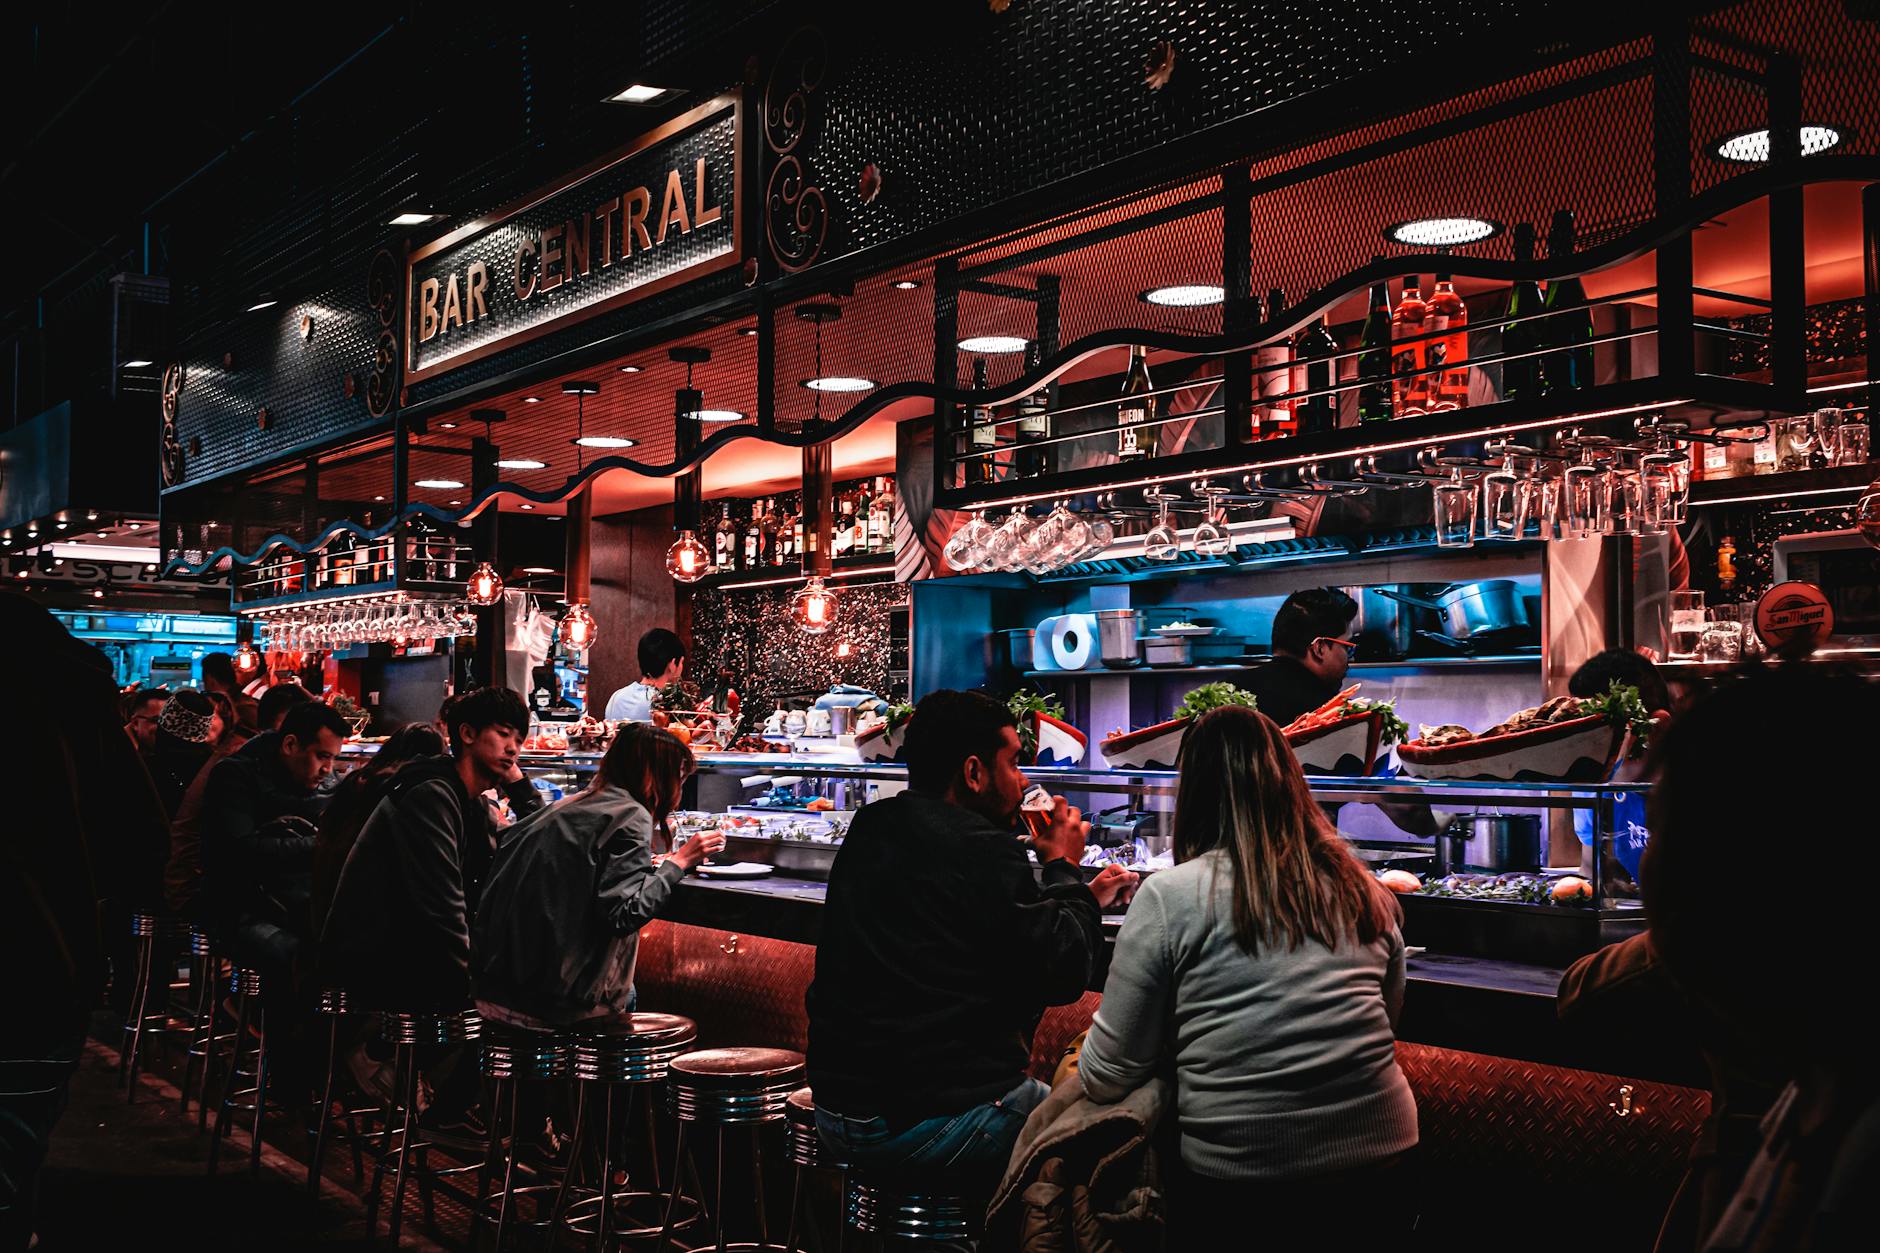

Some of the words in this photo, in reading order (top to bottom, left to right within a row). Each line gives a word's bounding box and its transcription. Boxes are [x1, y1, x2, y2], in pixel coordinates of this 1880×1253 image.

[419, 260, 488, 342] BAR
[513, 157, 722, 301] CENTRAL
[1764, 614, 1789, 629] San
[1788, 607, 1825, 624] Miguel
